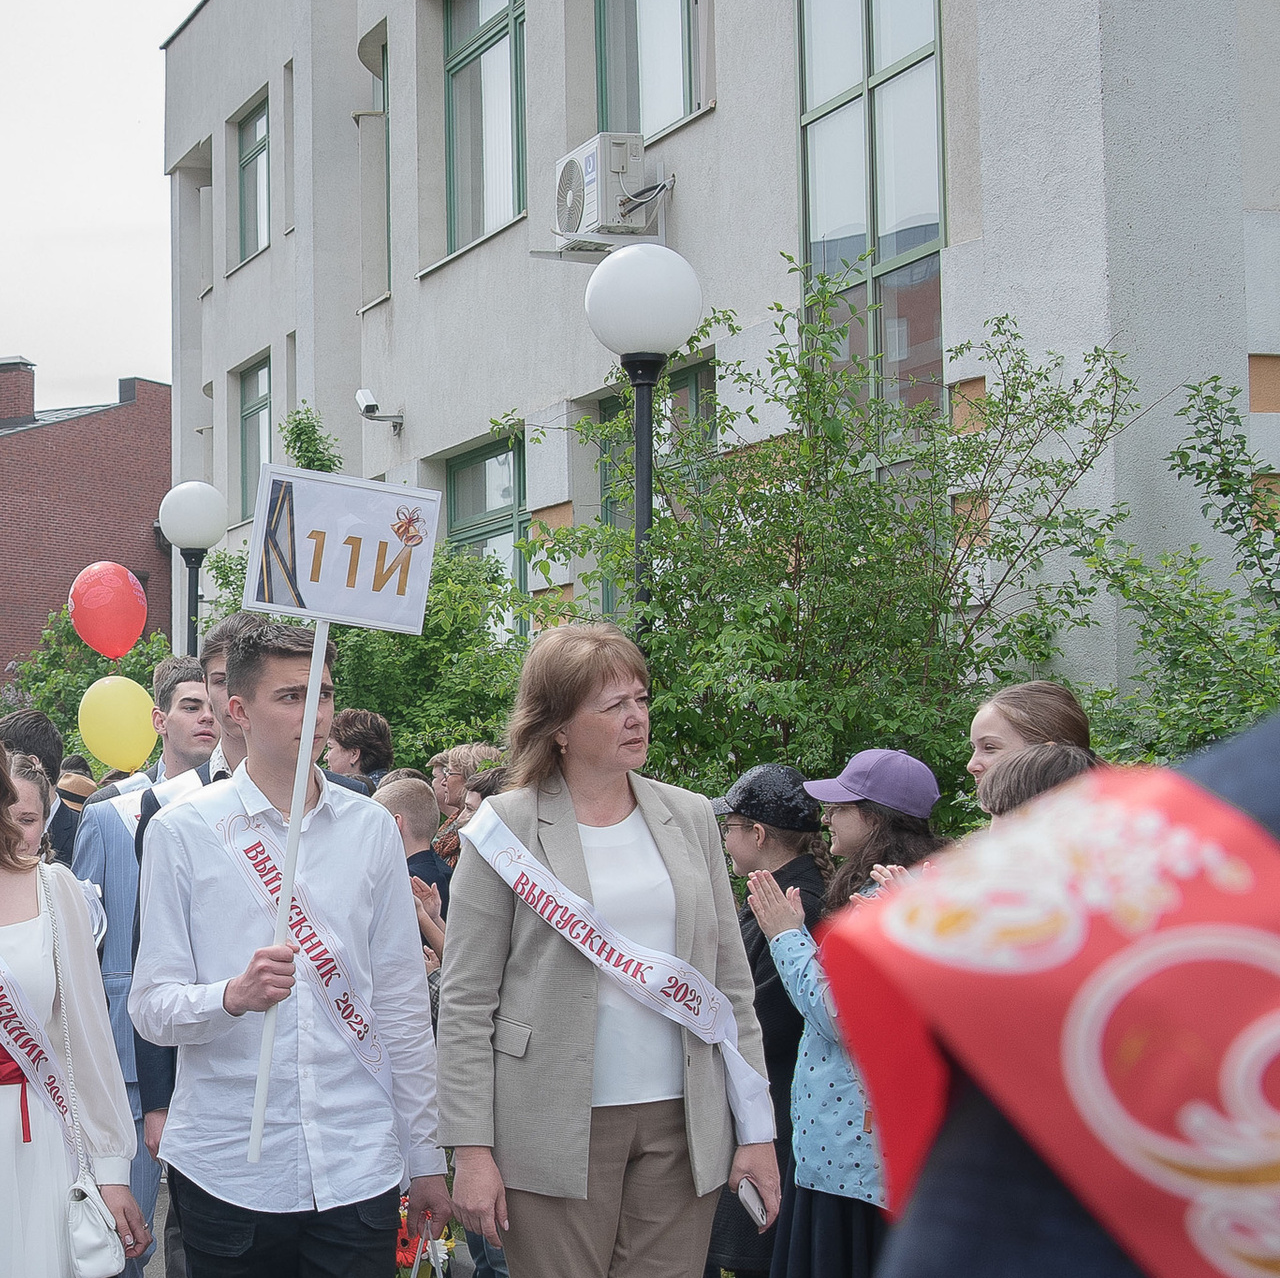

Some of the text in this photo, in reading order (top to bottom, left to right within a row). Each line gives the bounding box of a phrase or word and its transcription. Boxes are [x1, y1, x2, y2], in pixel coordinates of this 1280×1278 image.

[512, 871, 703, 1017] ВЫПУСКНИК 2023
[334, 992, 370, 1041] 2023
